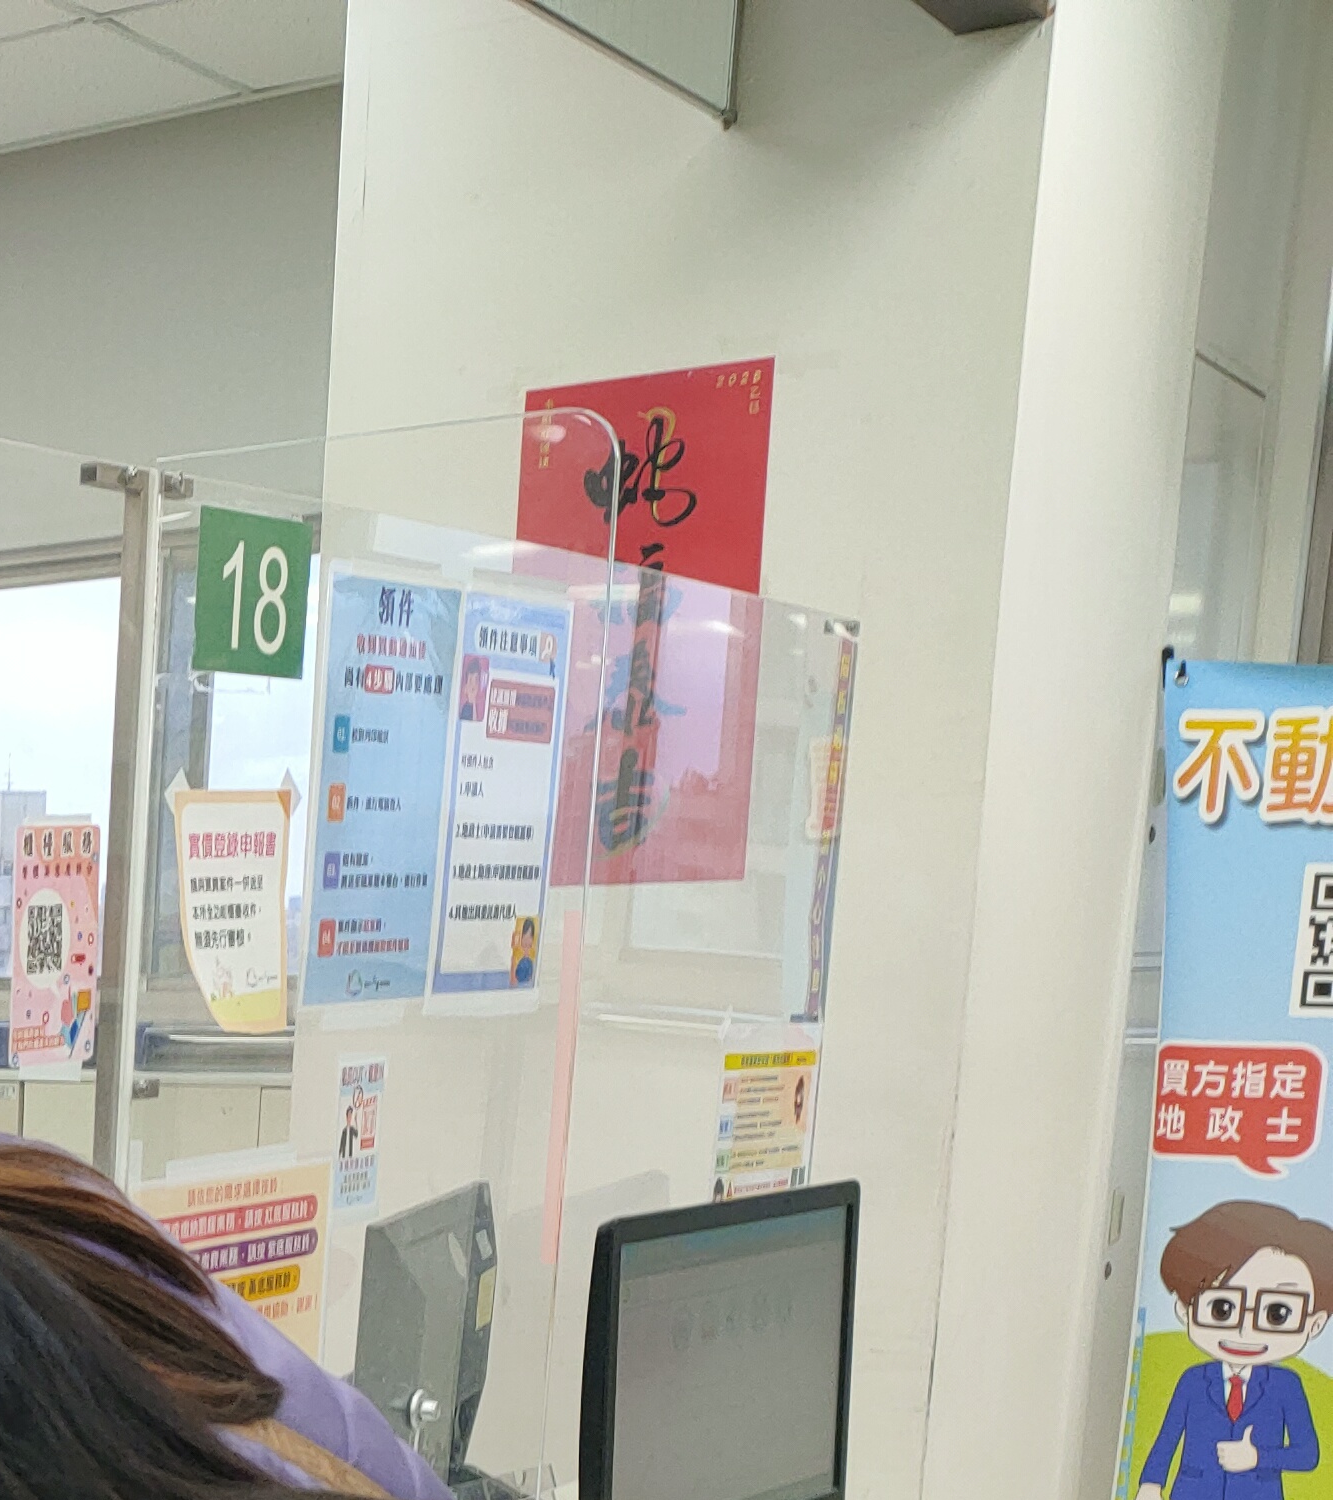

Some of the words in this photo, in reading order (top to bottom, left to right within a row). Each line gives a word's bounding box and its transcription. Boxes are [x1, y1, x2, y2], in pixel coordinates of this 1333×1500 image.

[222, 539, 289, 656] 18
[378, 586, 415, 628] 領件
[1160, 1058, 1307, 1100] 買方指定
[1156, 1105, 1302, 1143] 地政士
